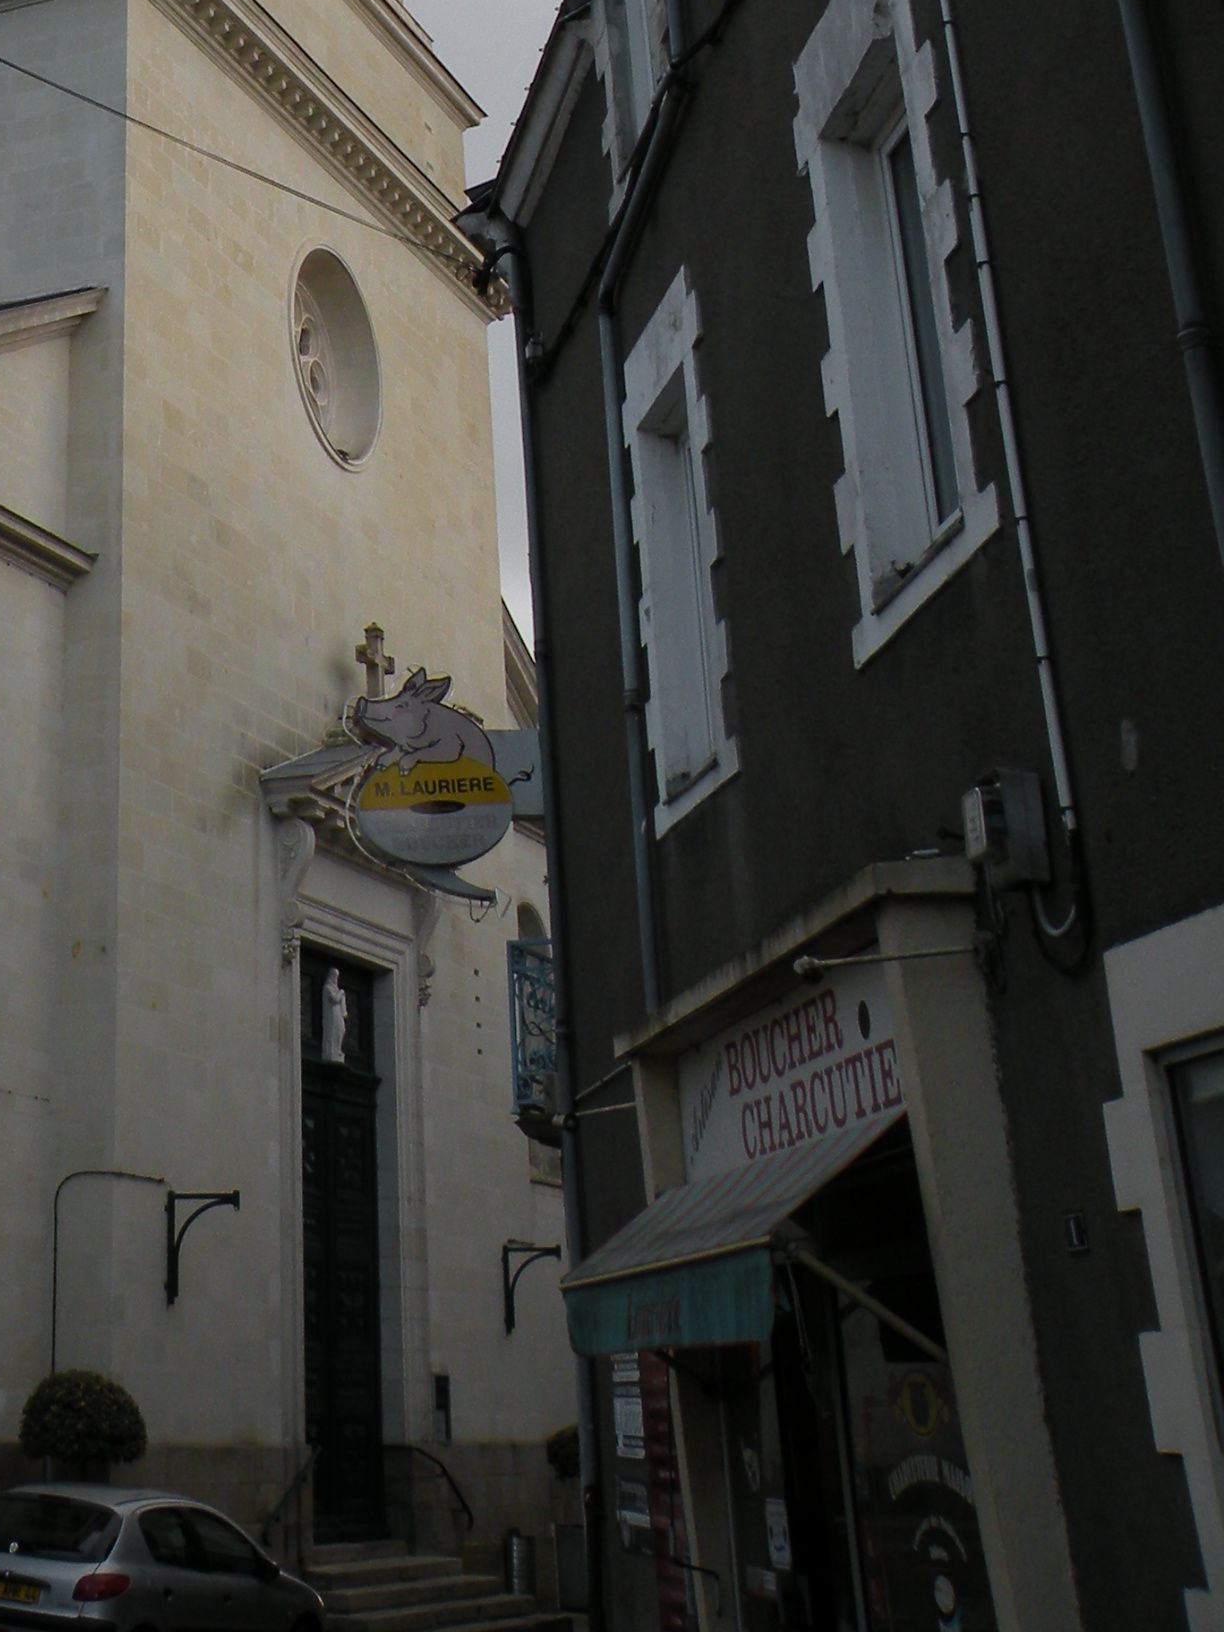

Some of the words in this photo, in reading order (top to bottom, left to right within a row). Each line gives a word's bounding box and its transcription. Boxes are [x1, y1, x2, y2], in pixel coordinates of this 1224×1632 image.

[375, 781, 394, 797] M.
[400, 776, 494, 796] LAURIERE
[724, 988, 843, 1097] BOUCHER
